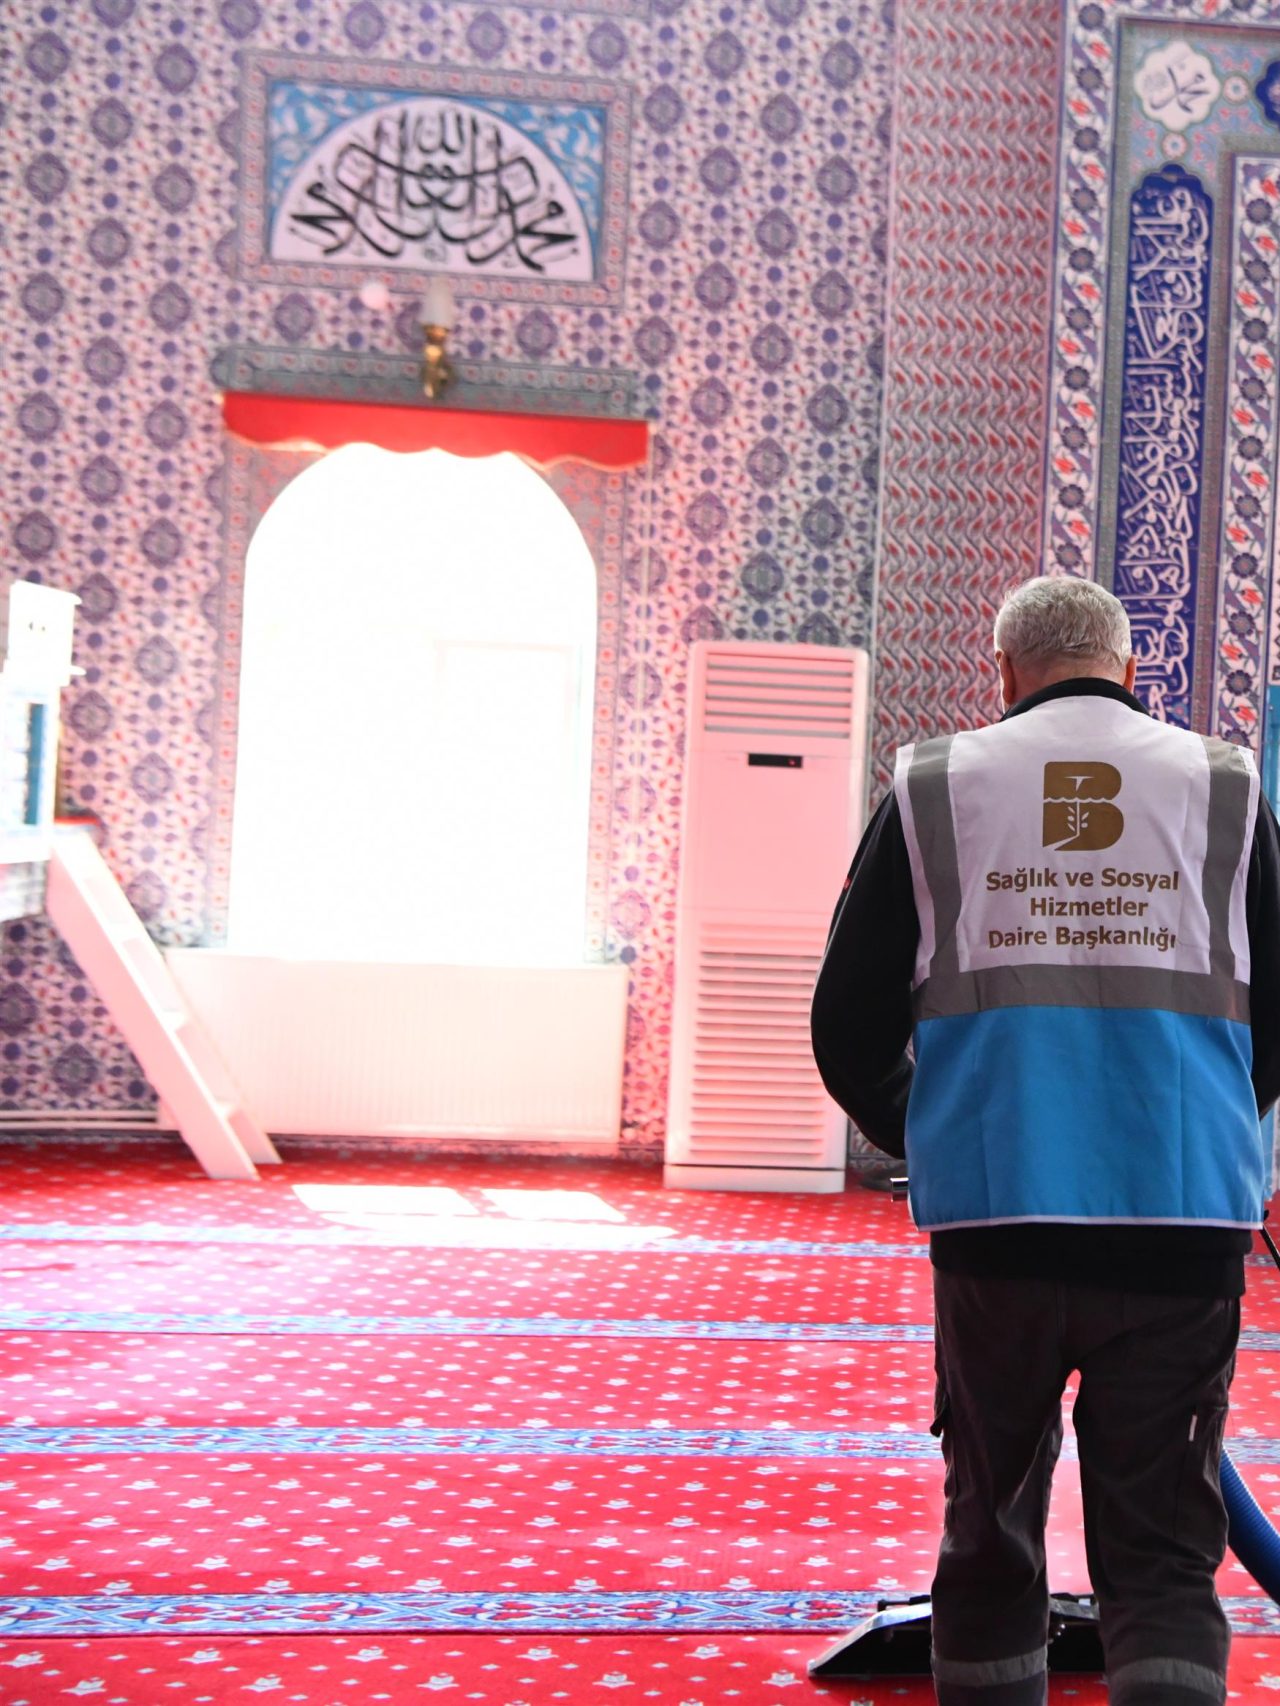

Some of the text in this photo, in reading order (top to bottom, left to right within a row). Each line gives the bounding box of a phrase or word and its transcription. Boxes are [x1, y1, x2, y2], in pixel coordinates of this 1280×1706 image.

[986, 867, 1179, 893] Sağlık ve Sosyal
[1030, 896, 1149, 917] Hizmetler
[988, 925, 1176, 952] Daire Başkanlığı
